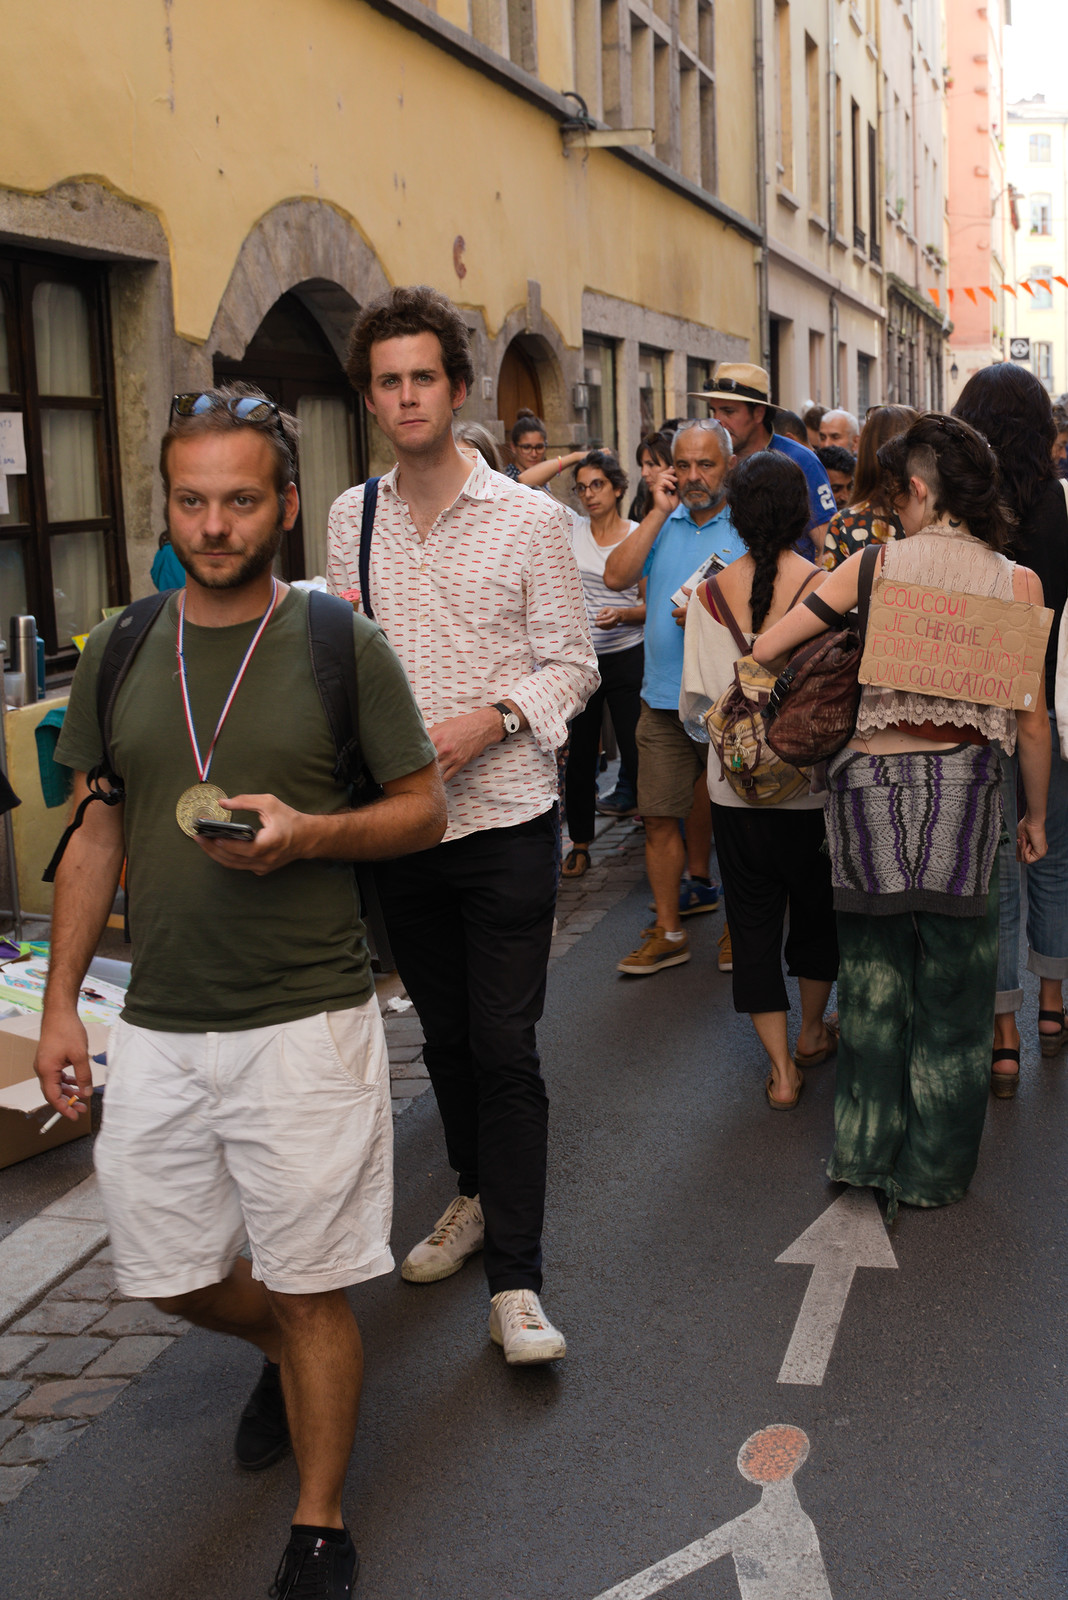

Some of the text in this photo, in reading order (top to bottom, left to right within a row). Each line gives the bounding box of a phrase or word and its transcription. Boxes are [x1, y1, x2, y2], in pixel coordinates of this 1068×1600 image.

[817, 483, 835, 511] 2
[885, 612, 909, 633] JE
[915, 616, 985, 647] CHERCHE
[876, 662, 1014, 699] UNE COLOCATION
